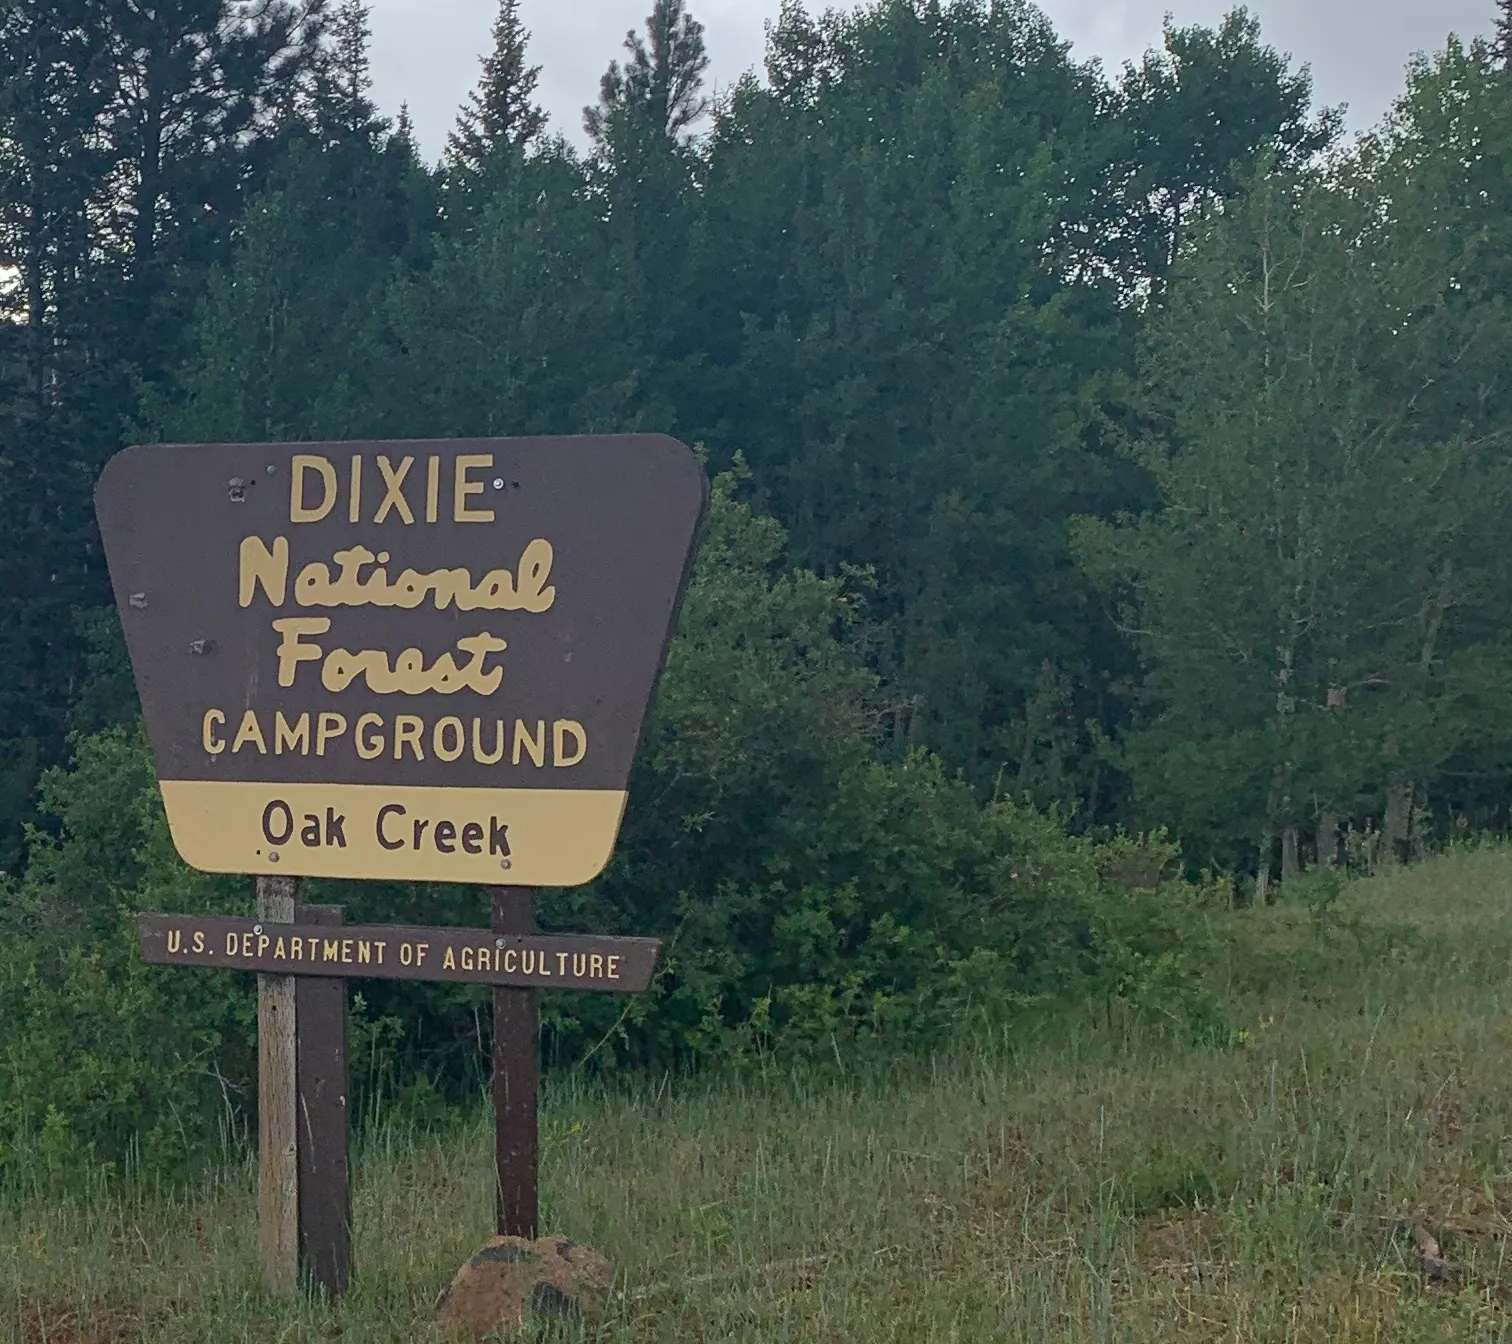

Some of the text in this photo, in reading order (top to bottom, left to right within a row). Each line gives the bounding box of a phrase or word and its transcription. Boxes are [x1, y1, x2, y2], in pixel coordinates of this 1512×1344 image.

[289, 453, 496, 525] DIXIE
[239, 535, 556, 614] National
[272, 616, 508, 696] Forest
[202, 708, 588, 769] CAMPGROUND
[262, 799, 512, 858] Oak Creek
[166, 929, 621, 979] U.S. DEPARTMENT OF AGRICULTURE
